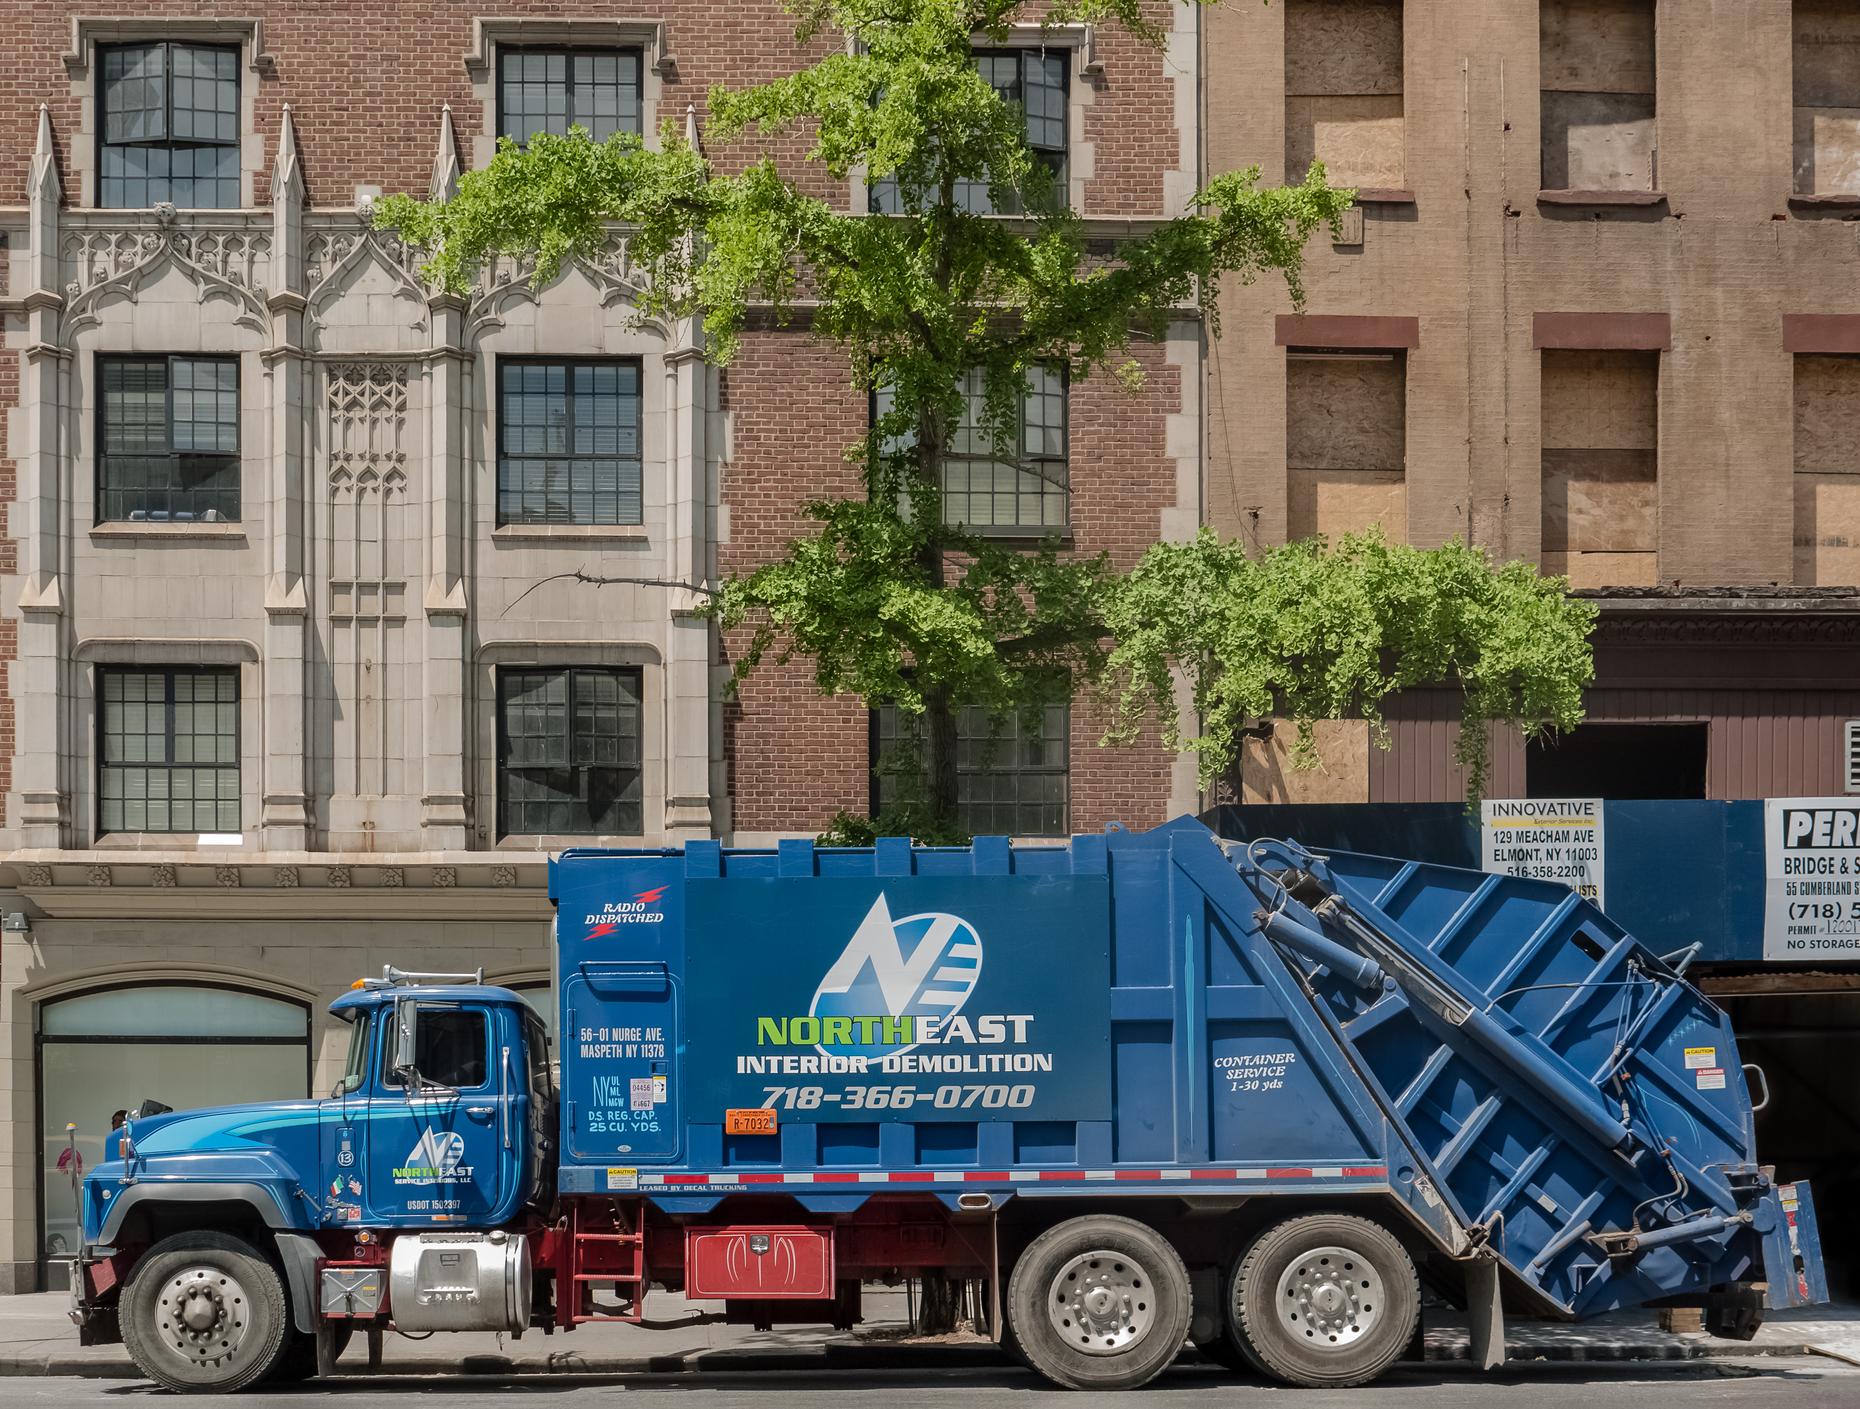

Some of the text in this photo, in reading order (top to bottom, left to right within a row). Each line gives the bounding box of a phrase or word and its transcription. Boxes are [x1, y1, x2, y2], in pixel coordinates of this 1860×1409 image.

[1493, 802, 1594, 816] INNOVATIVE
[1786, 811, 1860, 848] PER
[1494, 830, 1594, 844] 129 MEACHAM AVE
[1494, 848, 1598, 864] ELMONT, NY 11003
[1507, 865, 1585, 878] 516-358-2200
[1784, 857, 1835, 875] BRIDGE
[1840, 857, 1849, 874] &
[1786, 882, 1797, 896] 55
[1800, 881, 1852, 896] CUMBERLAND
[603, 902, 646, 913] RADIO
[1788, 901, 1842, 921] (718)
[584, 913, 664, 925] DISPATCHED
[1787, 925, 1817, 935] PERMIT
[1787, 939, 1860, 949] NO STORAGE
[581, 1027, 665, 1041] 56-01 NURGE AVE.
[757, 1015, 1035, 1045] NORTHEAST
[580, 1044, 664, 1058] MASPETH NY 11378
[736, 1053, 1053, 1074] INTERIOR DEMOLITION
[1214, 1052, 1296, 1068] CONTAINER
[1226, 1066, 1286, 1080] SERVICE
[610, 1087, 621, 1096] ML
[1231, 1079, 1284, 1092] 1-30 yds
[760, 1085, 1036, 1109] 718-366-0700
[607, 1111, 632, 1121] REG.
[633, 1111, 658, 1120] CAP.
[589, 1121, 662, 1132] 25 CU. YDS.
[734, 1117, 769, 1130] R-7032
[340, 1153, 352, 1163] 13
[392, 1166, 475, 1178] NORTHEAST
[407, 1199, 461, 1210] USDOT 1502397
